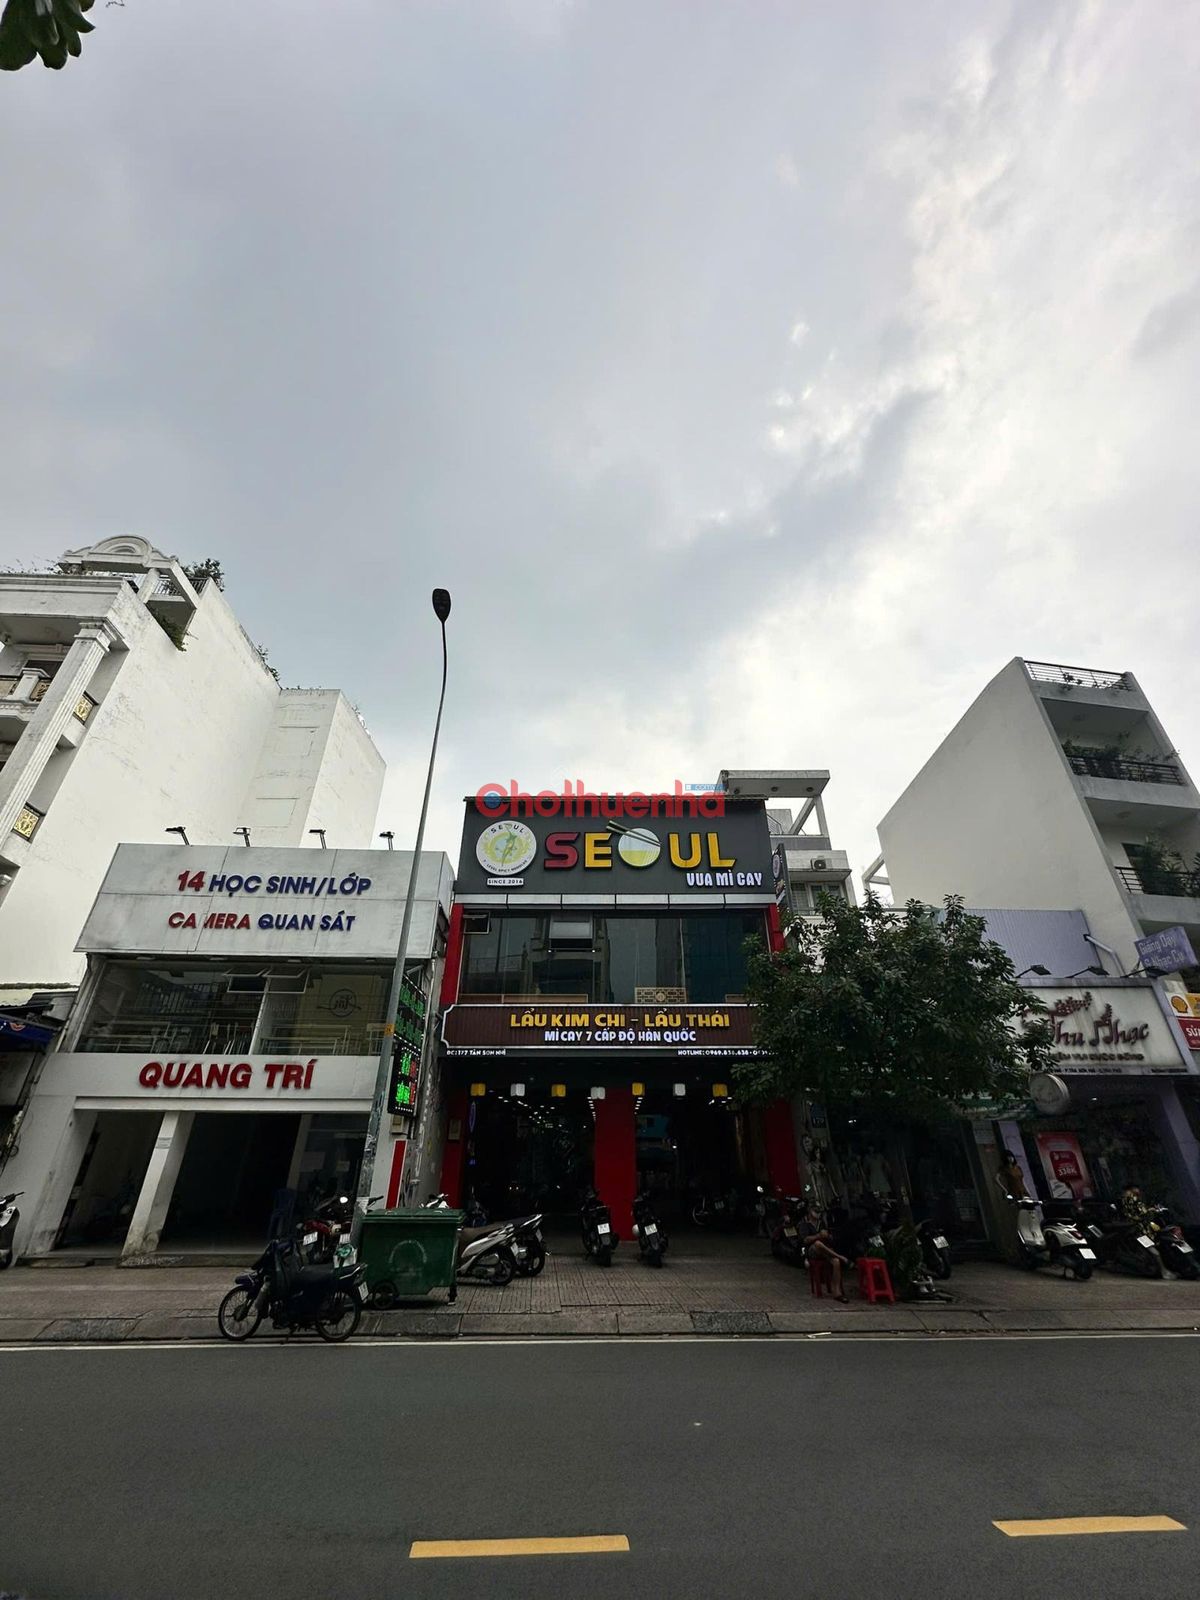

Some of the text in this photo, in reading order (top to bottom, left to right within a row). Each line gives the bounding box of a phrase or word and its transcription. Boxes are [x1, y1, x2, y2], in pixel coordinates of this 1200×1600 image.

[177, 870, 372, 897] 14 HỌC SINH/LỚP
[686, 869, 763, 887] VUA MÌ CAY
[257, 913, 315, 931] QUAN
[319, 910, 356, 932] SÁT
[510, 1007, 547, 1027] LẨU
[550, 1013, 589, 1027] KIM
[594, 1013, 626, 1027] CHI
[644, 1007, 681, 1027] LẨU
[685, 1010, 730, 1027] THÁI
[544, 1027, 697, 1044] MÌ CAY 7 CẤP ĐỘ HÀN QUỐC
[138, 1059, 318, 1089] QUANG TRÍ
